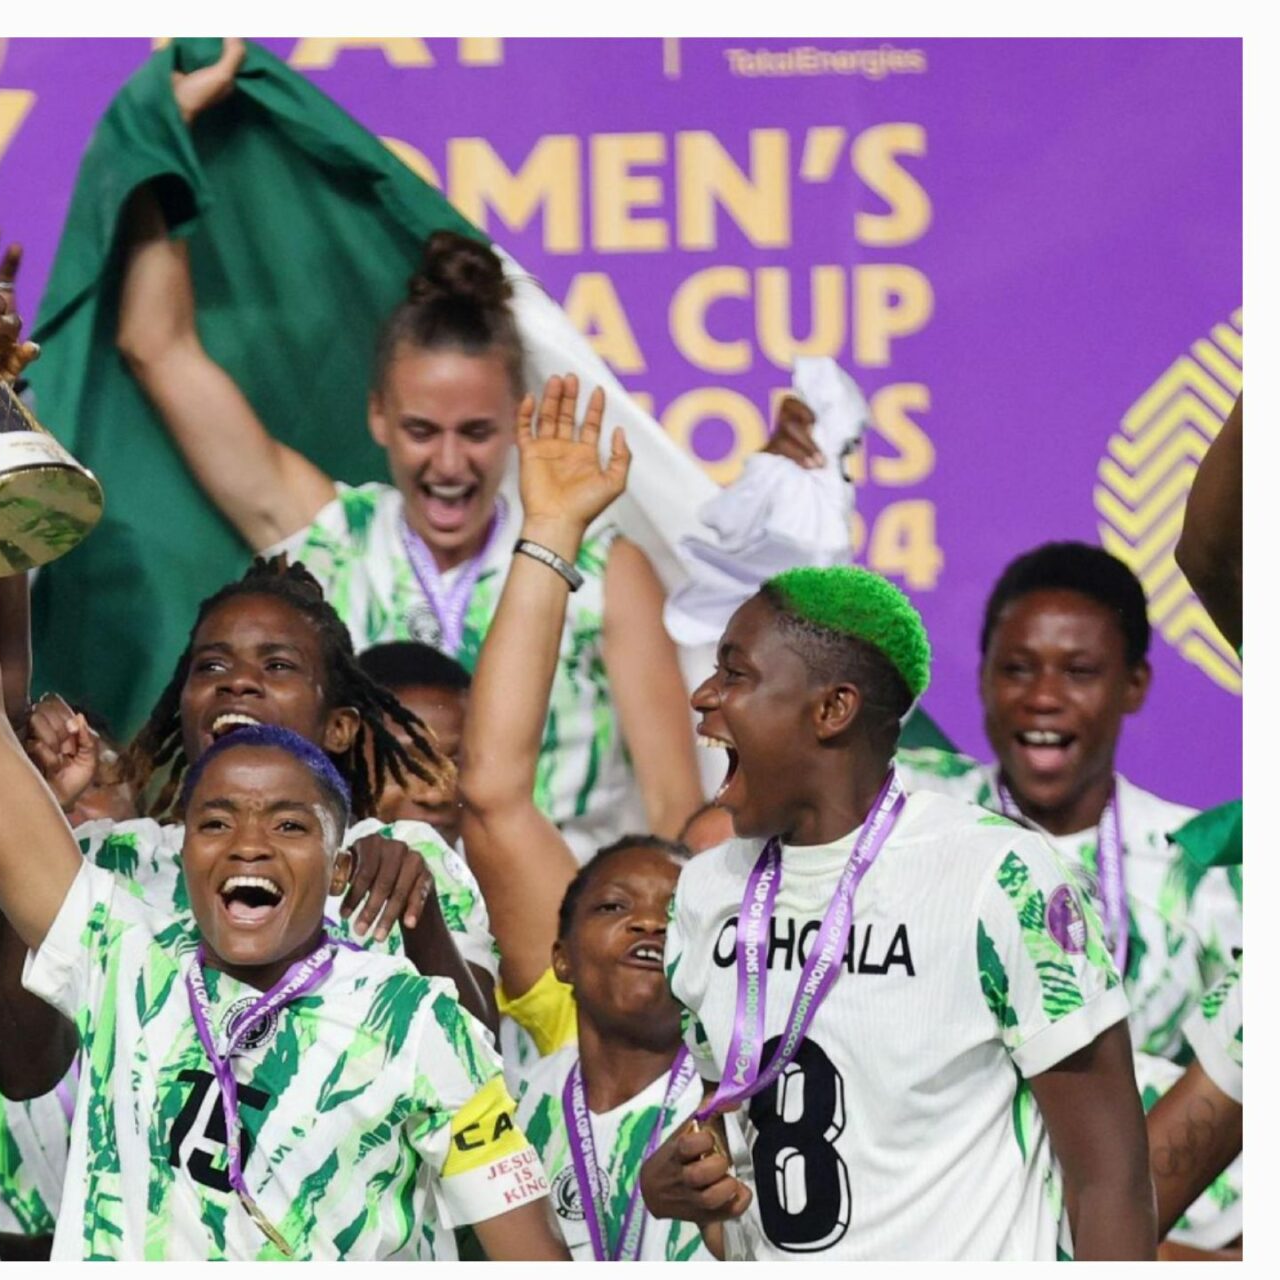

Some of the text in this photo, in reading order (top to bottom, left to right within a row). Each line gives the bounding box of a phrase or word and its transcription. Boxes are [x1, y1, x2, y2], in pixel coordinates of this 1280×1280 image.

[669, 264, 934, 374] CUP
[745, 919, 761, 973] NATIONS
[804, 943, 835, 996] NATIONS
[783, 994, 812, 1057] MOROCCO
[748, 1034, 851, 1253] 8
[515, 1168, 533, 1184] IS
